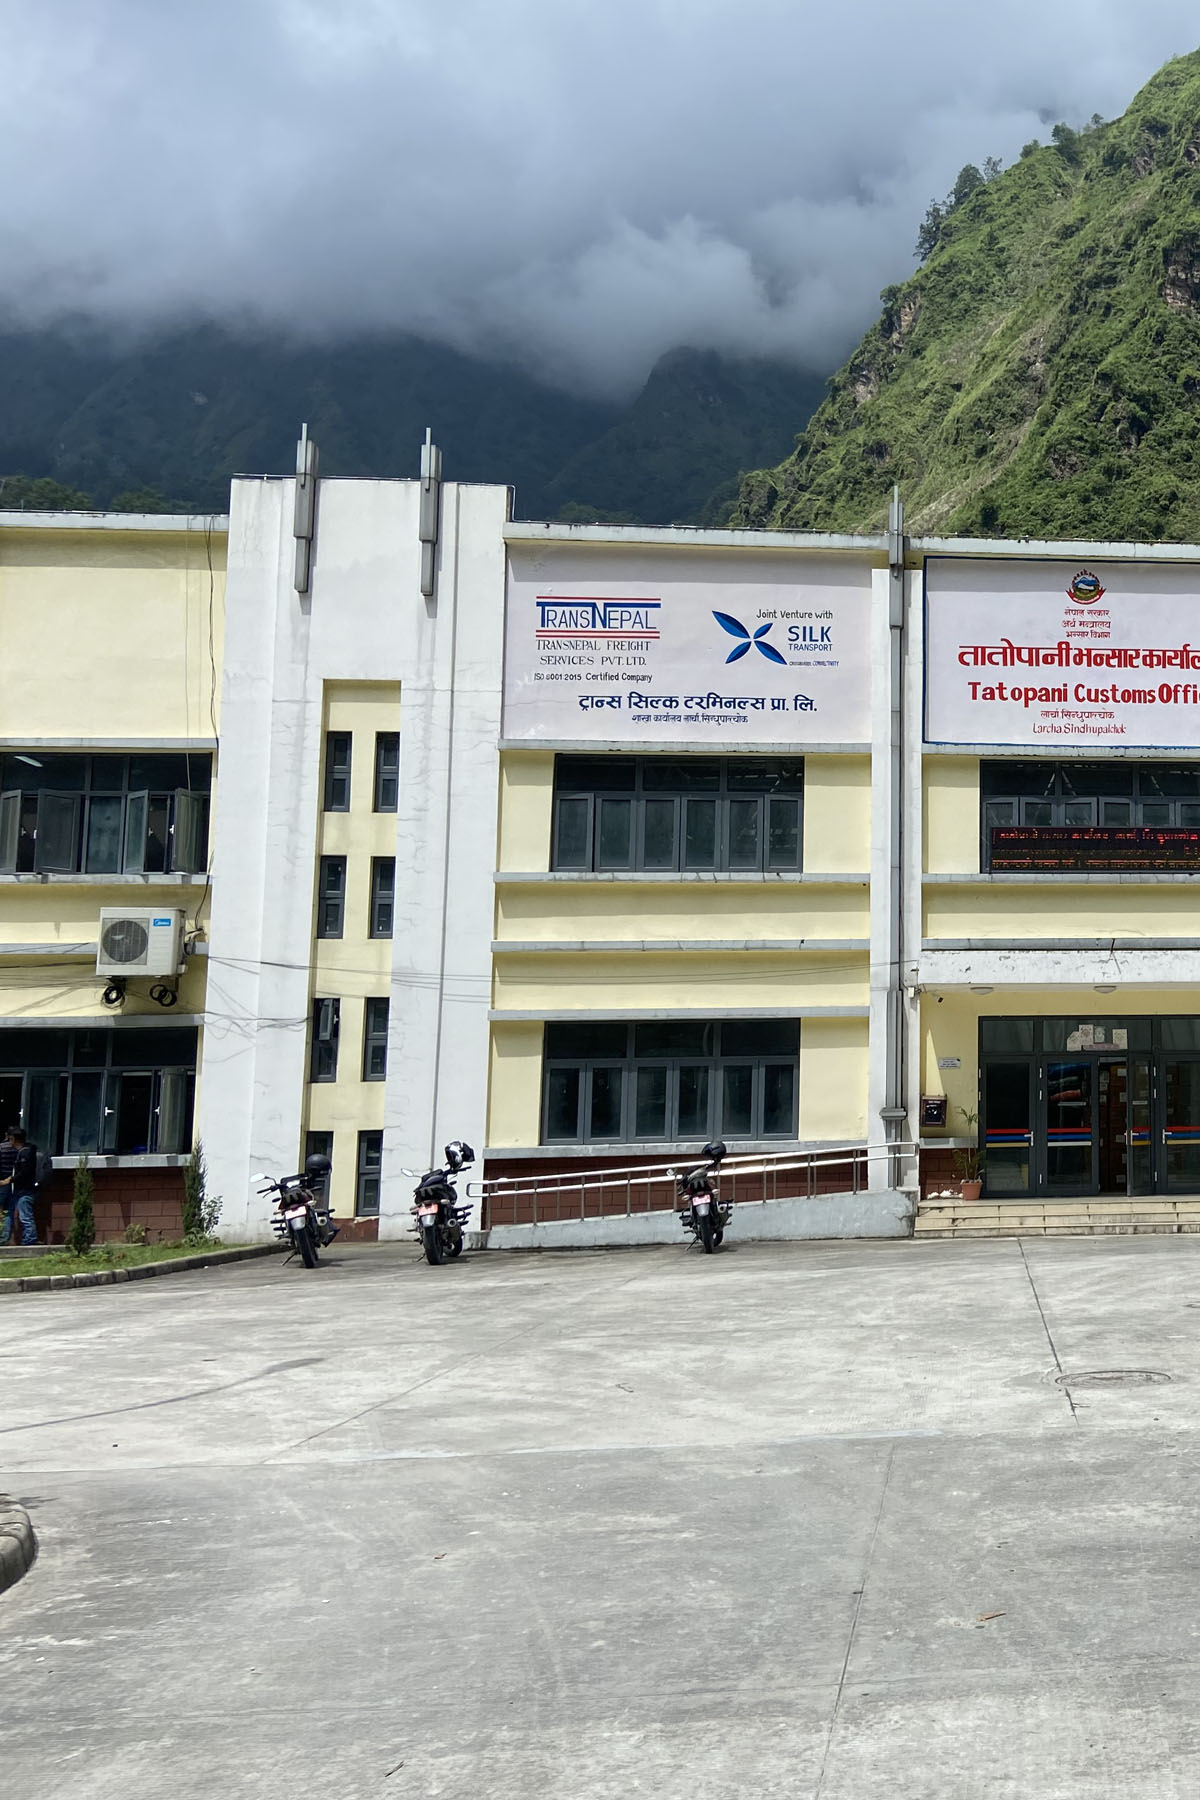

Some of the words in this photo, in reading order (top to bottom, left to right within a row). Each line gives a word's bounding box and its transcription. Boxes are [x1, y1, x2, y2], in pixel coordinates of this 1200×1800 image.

[756, 609, 777, 619] Joint
[780, 609, 813, 619] Venture
[815, 610, 833, 619] with
[788, 625, 832, 643] SILK
[536, 640, 601, 651] TRANSNEPAL
[606, 640, 651, 652] FREIGHT
[788, 643, 833, 652] TRANSPORT
[958, 638, 1072, 667] तातोपानी
[1072, 647, 1140, 668] भन्सार
[540, 655, 595, 666] SERVICES
[585, 672, 620, 681] Certified
[621, 673, 653, 684] Company
[967, 681, 1068, 708] Tatopani
[1074, 683, 1156, 704] Customs
[578, 694, 622, 711] ट्रान्स
[627, 691, 680, 709] सिल्क
[683, 692, 767, 711] टरमिनल्स
[770, 696, 790, 711] प्रा.
[793, 694, 818, 712] लि.
